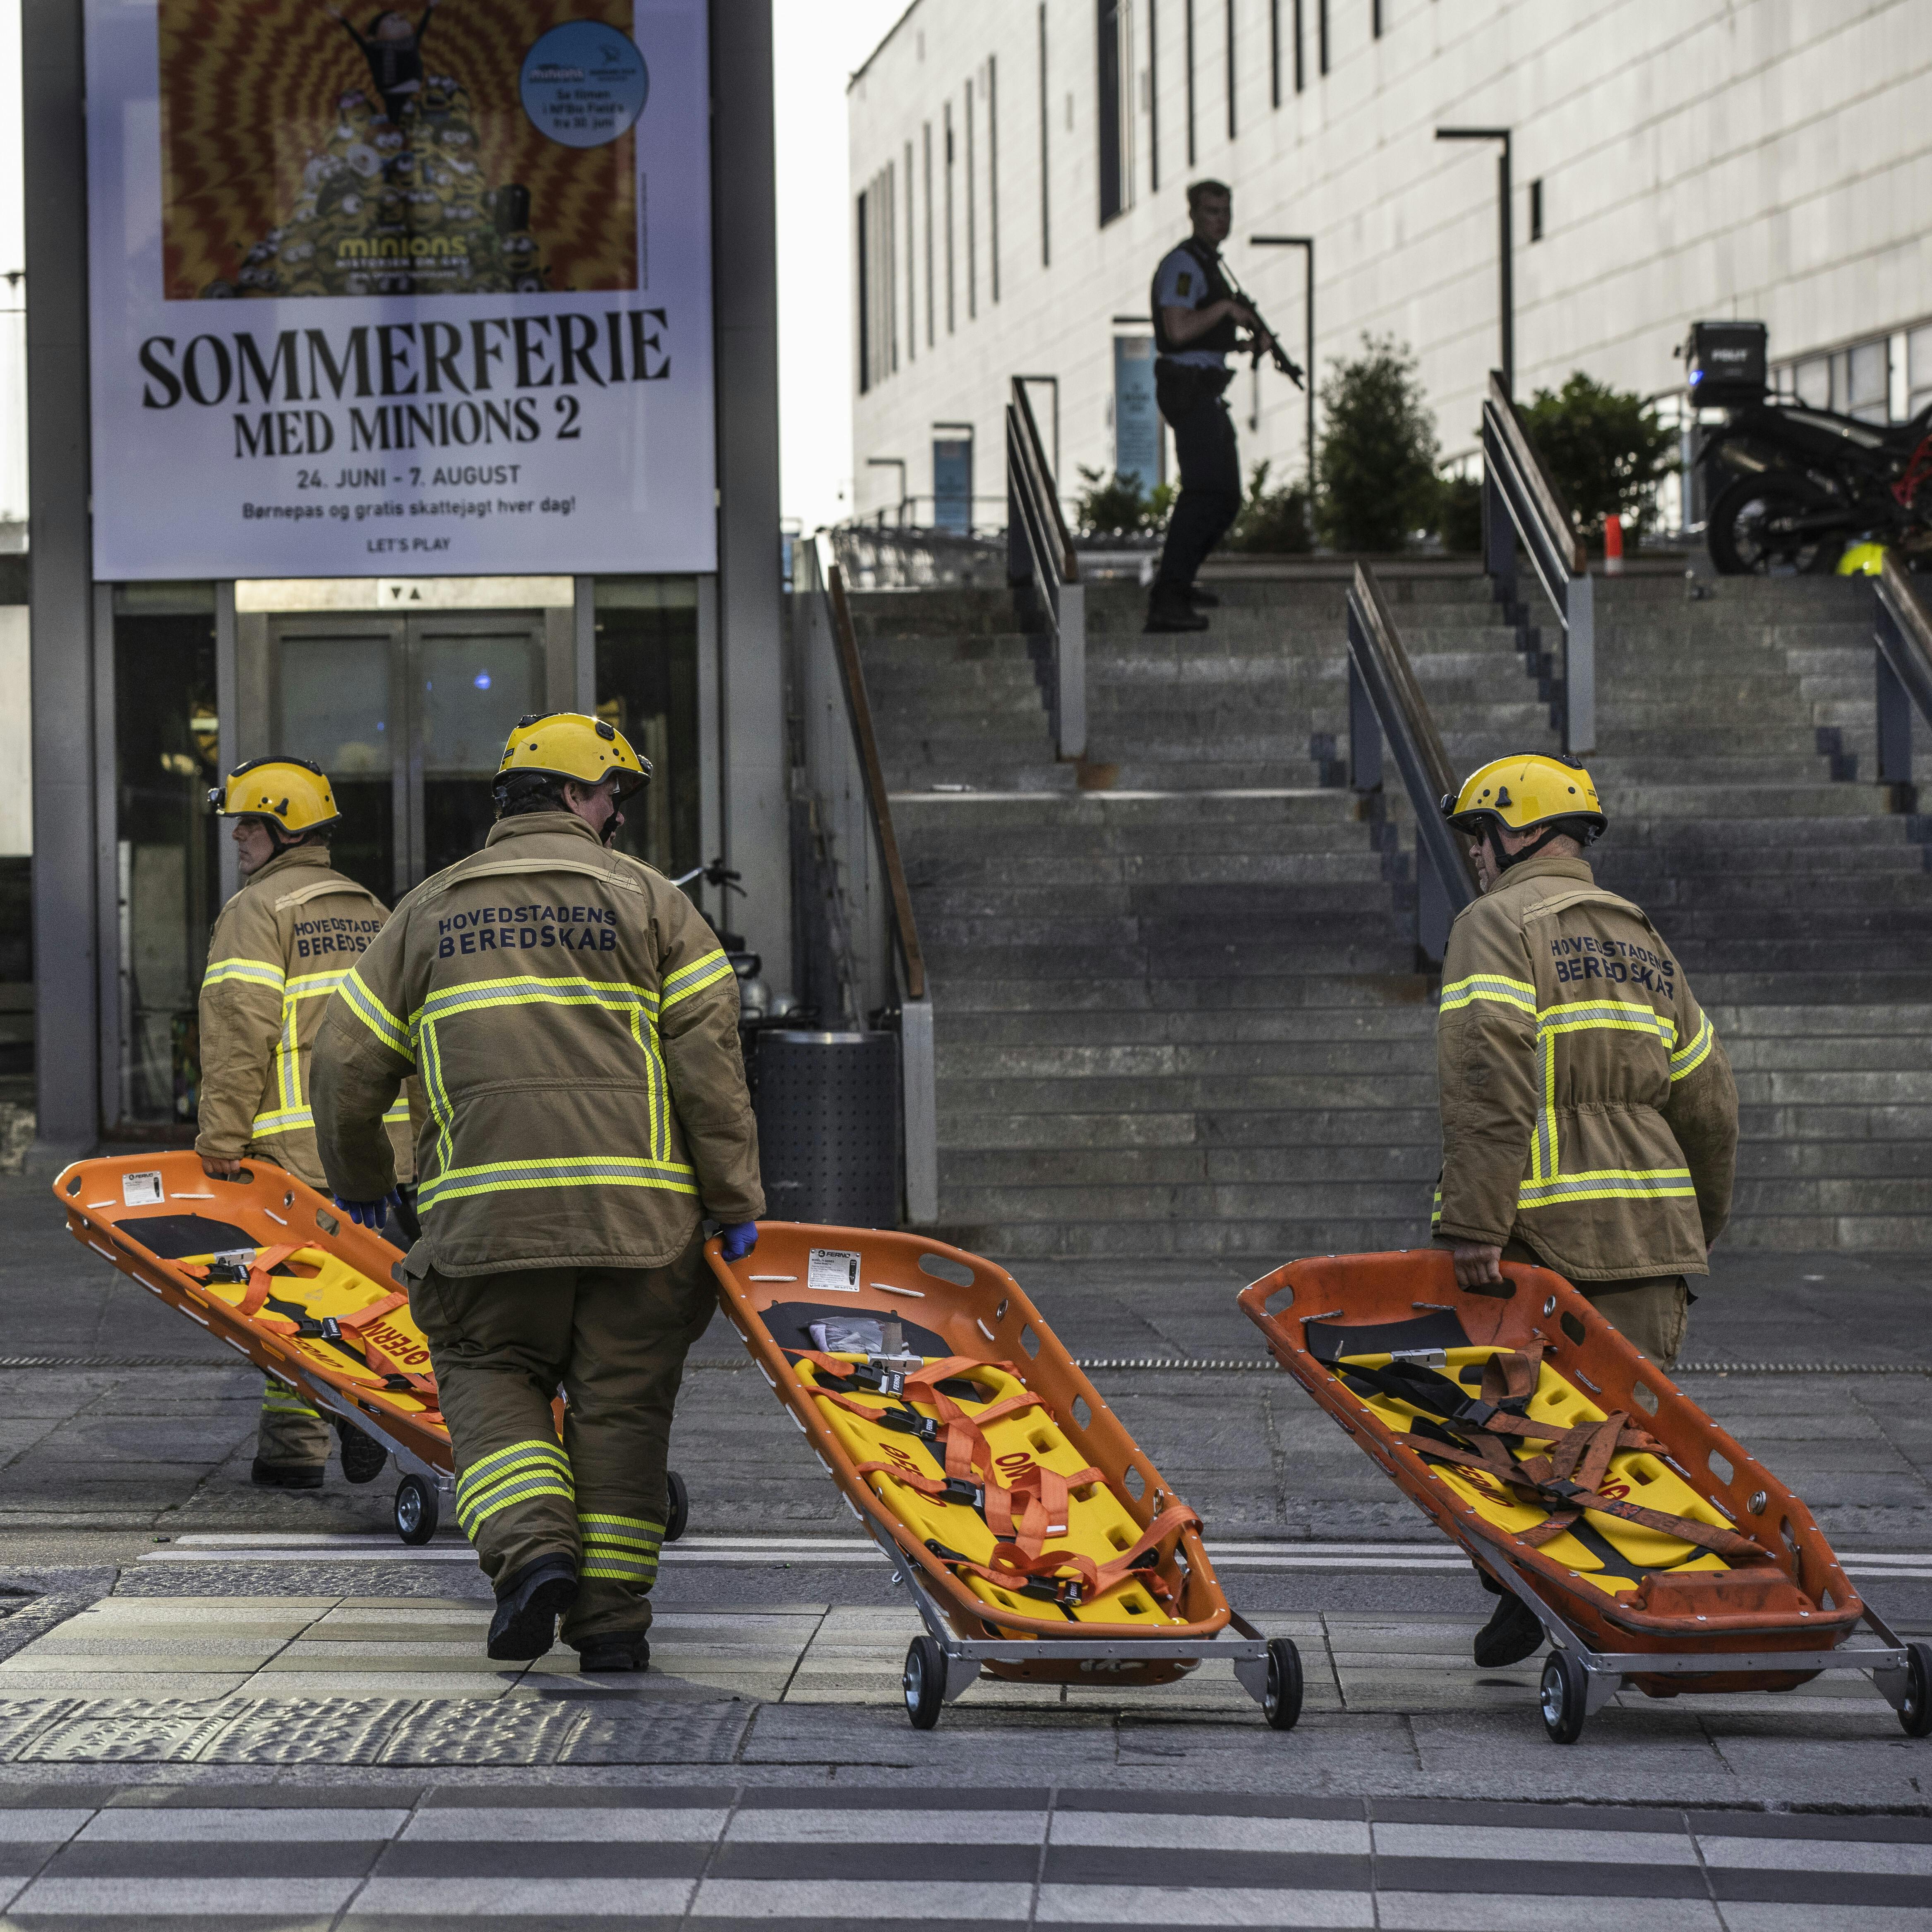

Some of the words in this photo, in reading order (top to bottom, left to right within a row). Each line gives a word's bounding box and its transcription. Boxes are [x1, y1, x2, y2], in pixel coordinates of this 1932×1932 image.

[338, 235, 467, 257] minions
[139, 308, 671, 410] SOMMERFERIE
[233, 409, 335, 458] MED
[348, 396, 540, 452] MINIONS
[554, 394, 581, 439] 2
[297, 469, 328, 490] 24.
[336, 467, 386, 489] JUNI
[409, 466, 426, 487] 7.
[432, 464, 521, 486] AUGUST
[242, 502, 324, 522] Børnepas
[329, 505, 350, 522] og
[355, 499, 405, 522] gratis
[409, 497, 492, 520] skattejagt
[497, 497, 534, 514] hver
[540, 495, 576, 516] dag!
[366, 538, 409, 554] LET'S
[413, 537, 451, 553] PLAY
[294, 917, 383, 935] HOVEDSTADE
[439, 904, 617, 935] HOVEDSTADENS
[297, 934, 372, 958] BEREDS
[439, 925, 617, 959] BEREDSKAB
[1550, 936, 1674, 977] HOVEDSTADENS
[329, 1319, 338, 1332] FERNO
[357, 1318, 421, 1356] FERN
[893, 1374, 901, 1394] FERNO
